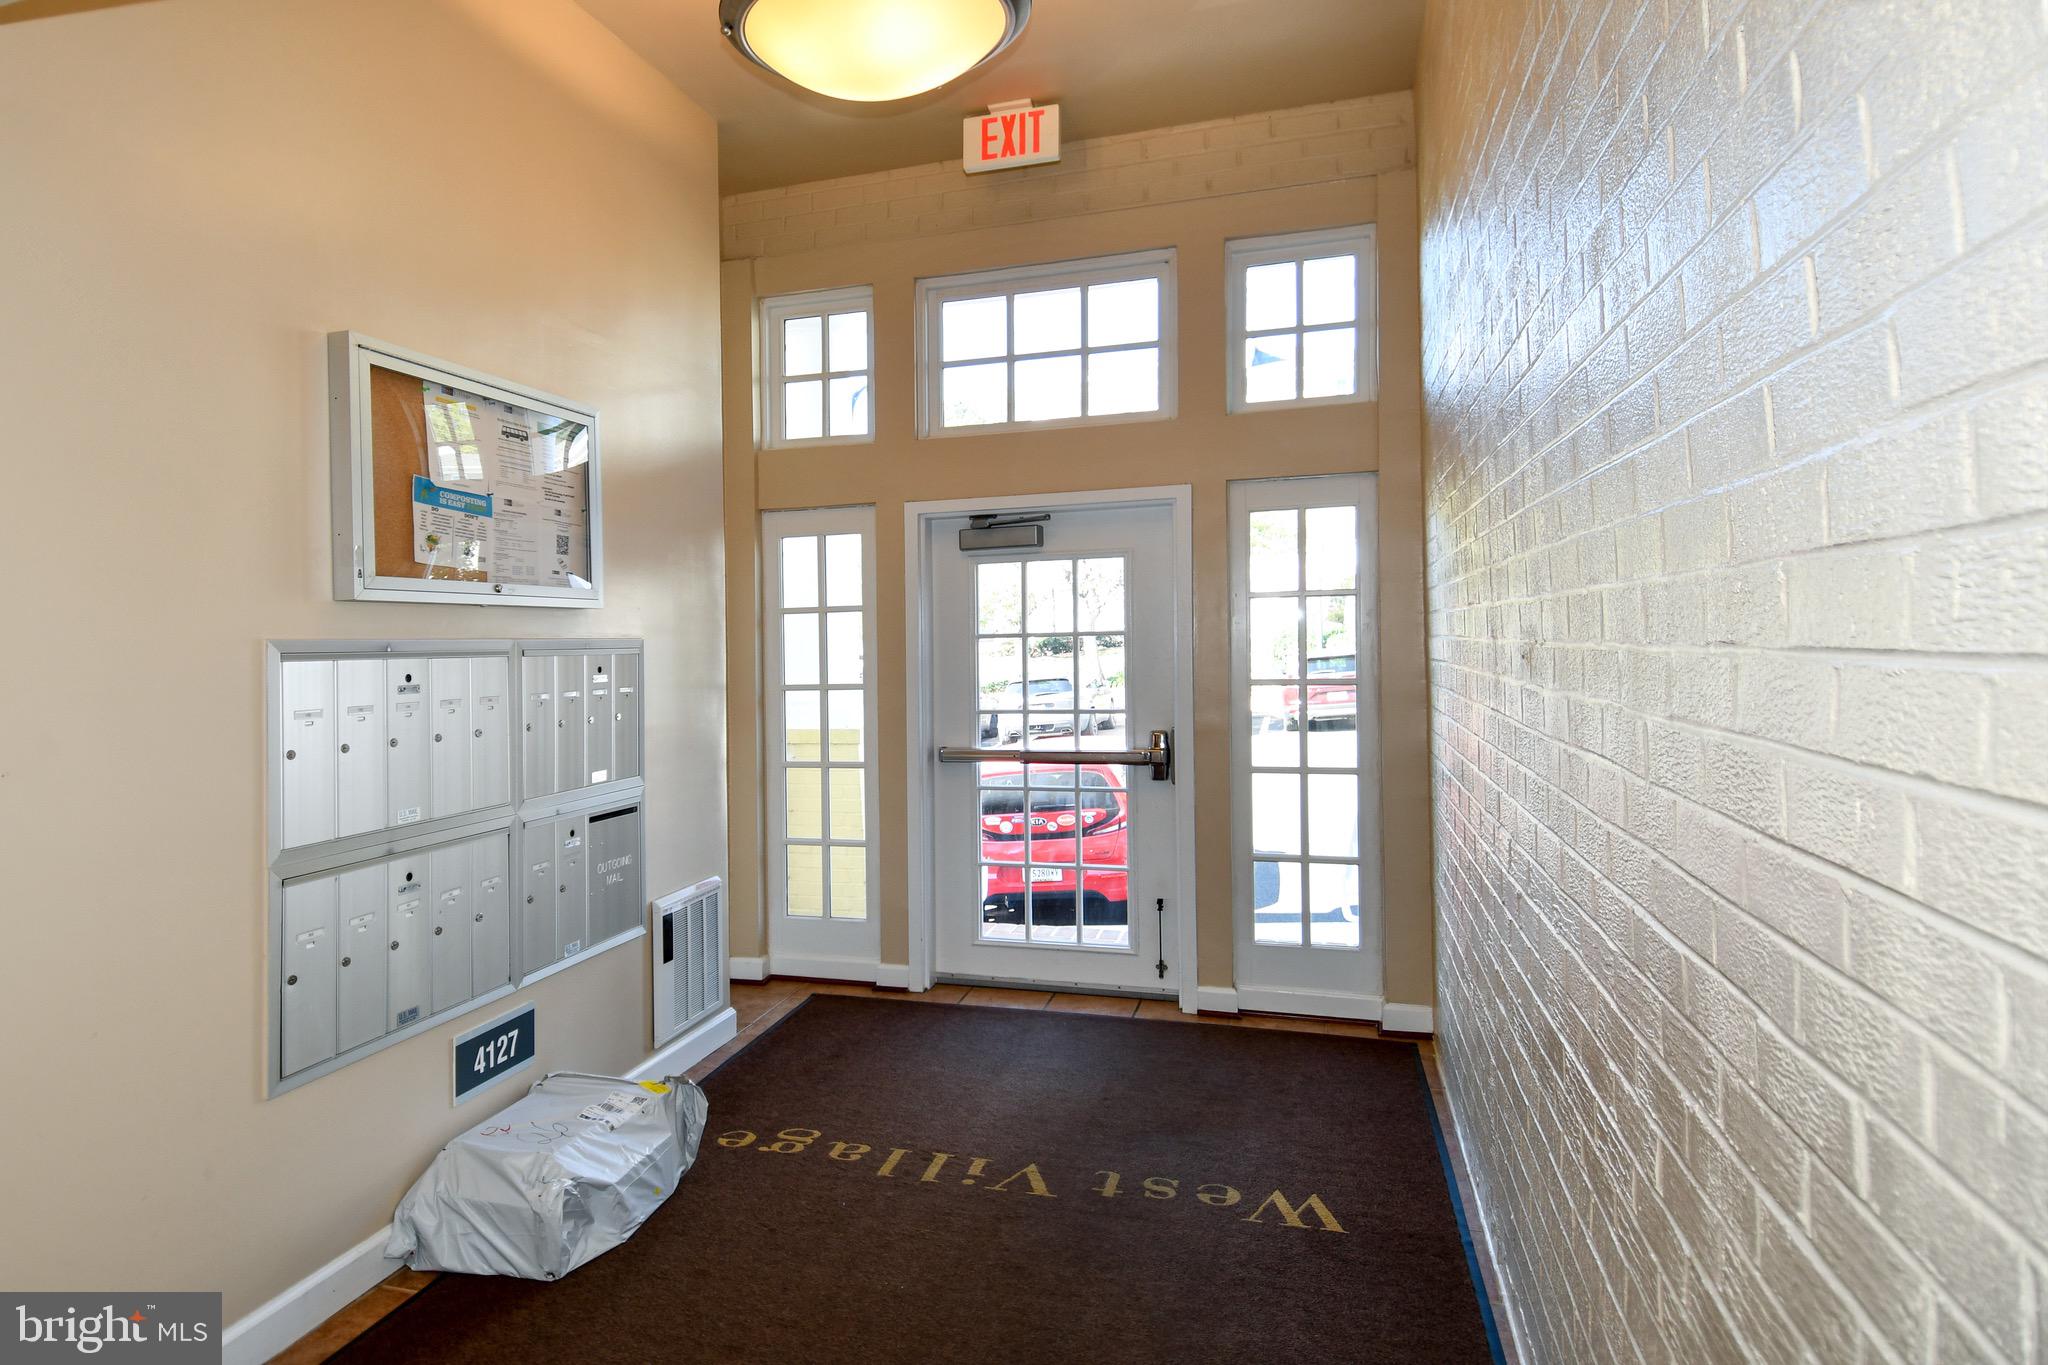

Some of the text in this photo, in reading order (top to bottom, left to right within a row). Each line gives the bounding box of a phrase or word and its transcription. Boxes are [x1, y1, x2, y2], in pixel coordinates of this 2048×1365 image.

[981, 109, 1045, 161] EXIT
[439, 490, 487, 507] COMPOSTING
[439, 497, 447, 505] IS
[447, 500, 466, 509] EASY
[597, 854, 632, 874] OUTGOING
[606, 872, 623, 886] MAIL
[473, 1028, 519, 1075] 4127
[716, 1127, 1351, 1236] West Village
